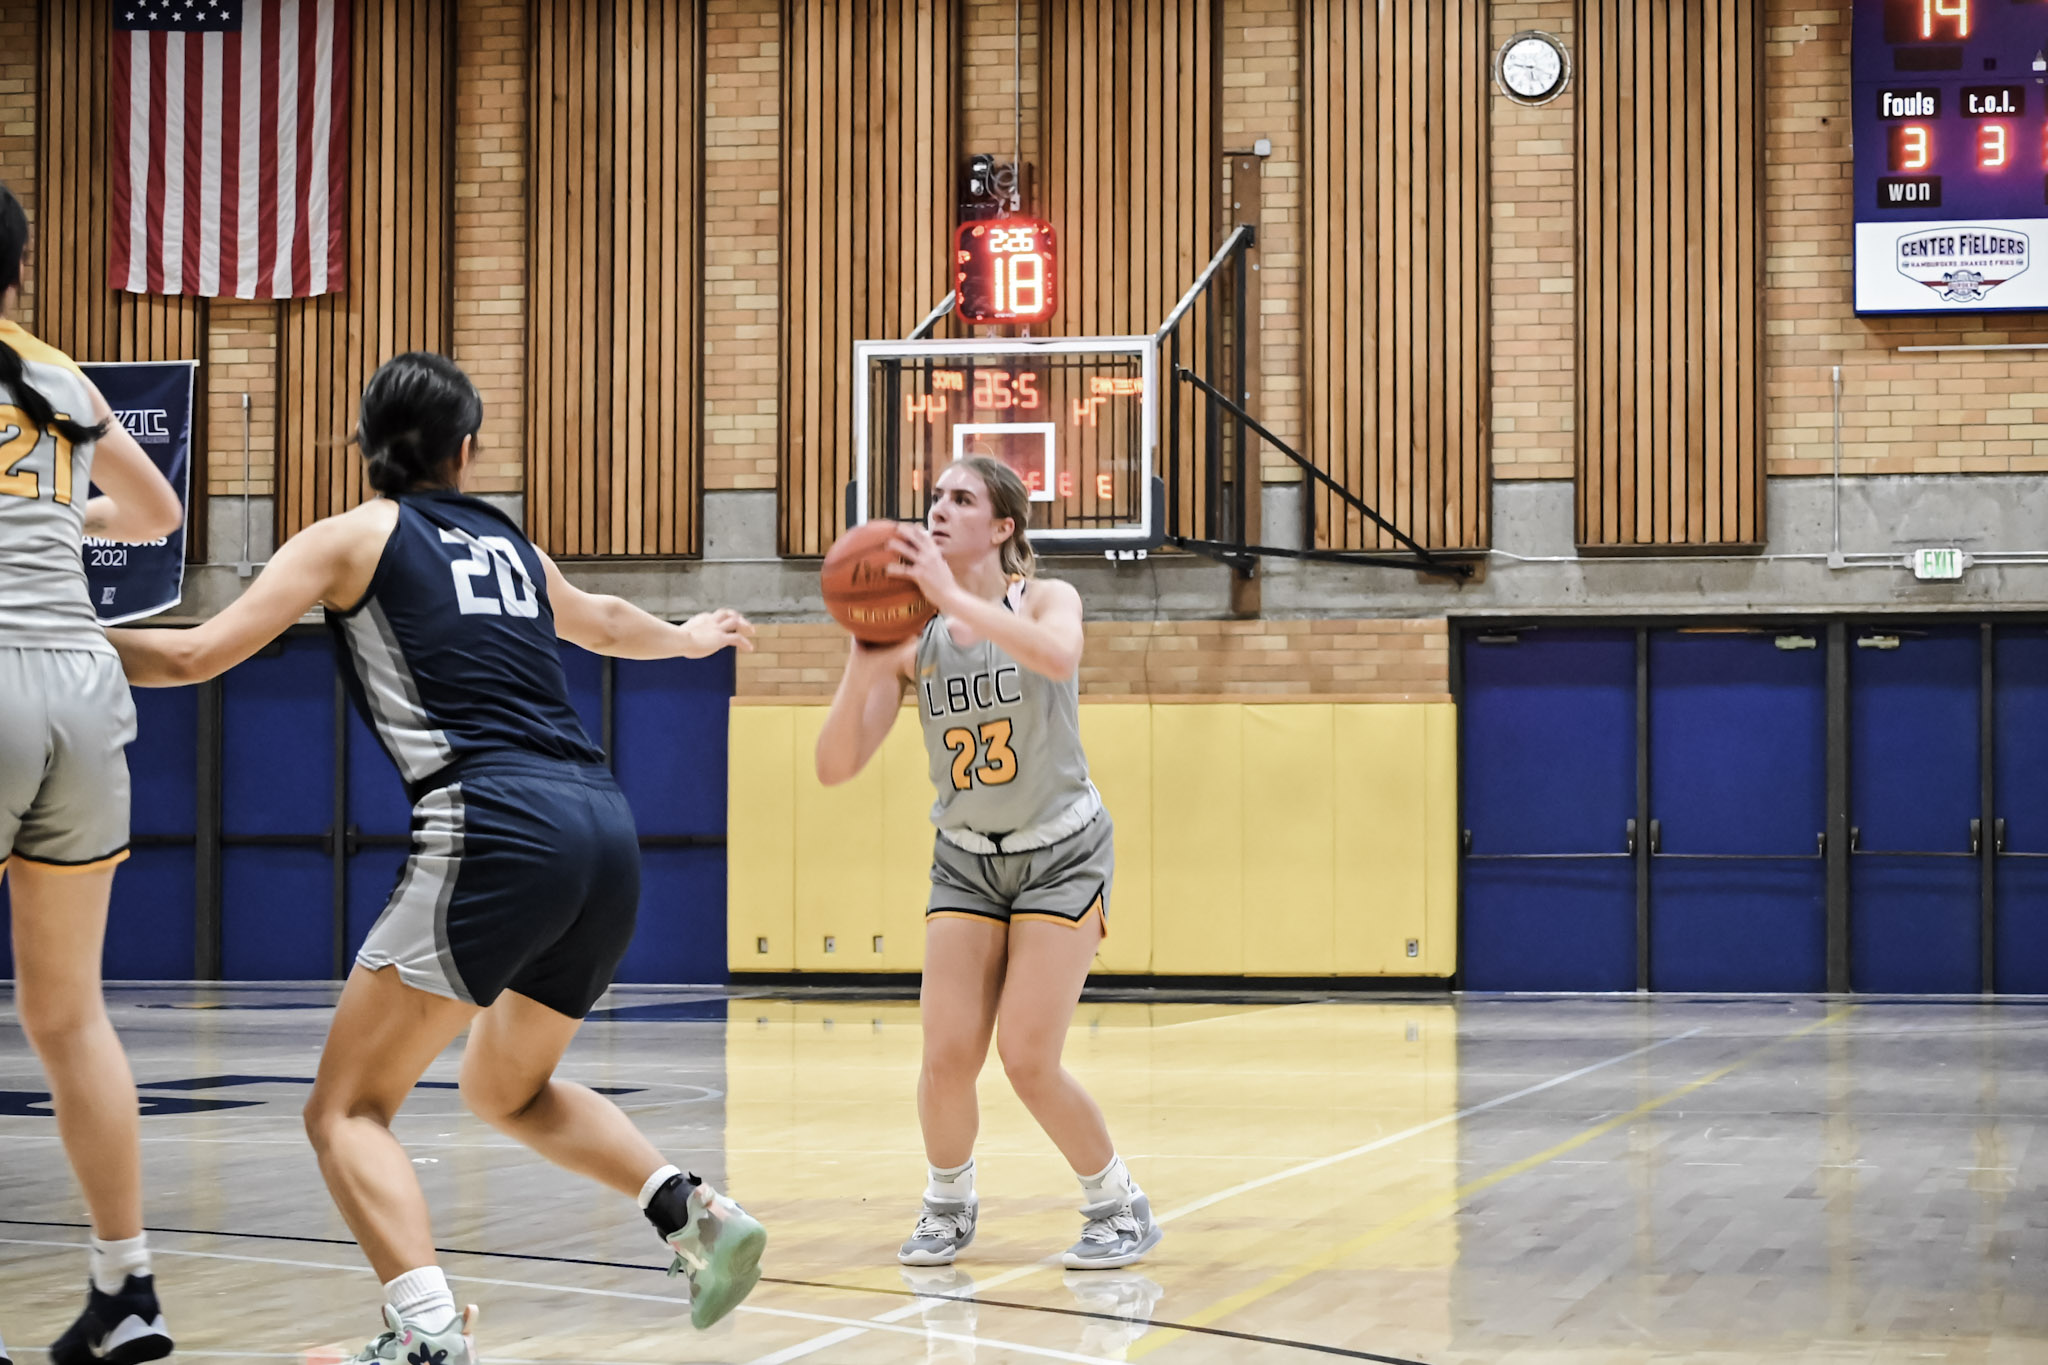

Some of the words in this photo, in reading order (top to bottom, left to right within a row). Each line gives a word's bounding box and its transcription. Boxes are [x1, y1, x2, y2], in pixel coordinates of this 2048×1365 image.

[1922, 0, 1968, 37] 14
[1883, 92, 1935, 117] fouls
[1969, 90, 2016, 113] t.o.l.
[1904, 127, 1927, 168] 3
[1983, 125, 2005, 166] 3
[1888, 182, 1930, 201] won
[989, 228, 1034, 253] 2:26
[1901, 237, 1955, 257] CENTER
[995, 253, 1043, 314] 18
[0, 404, 73, 506] 21
[91, 549, 128, 567] 2021
[438, 527, 539, 619] 20
[1923, 551, 1956, 576] EXIT
[923, 664, 1022, 720] LBCC
[943, 718, 1019, 791] 23
